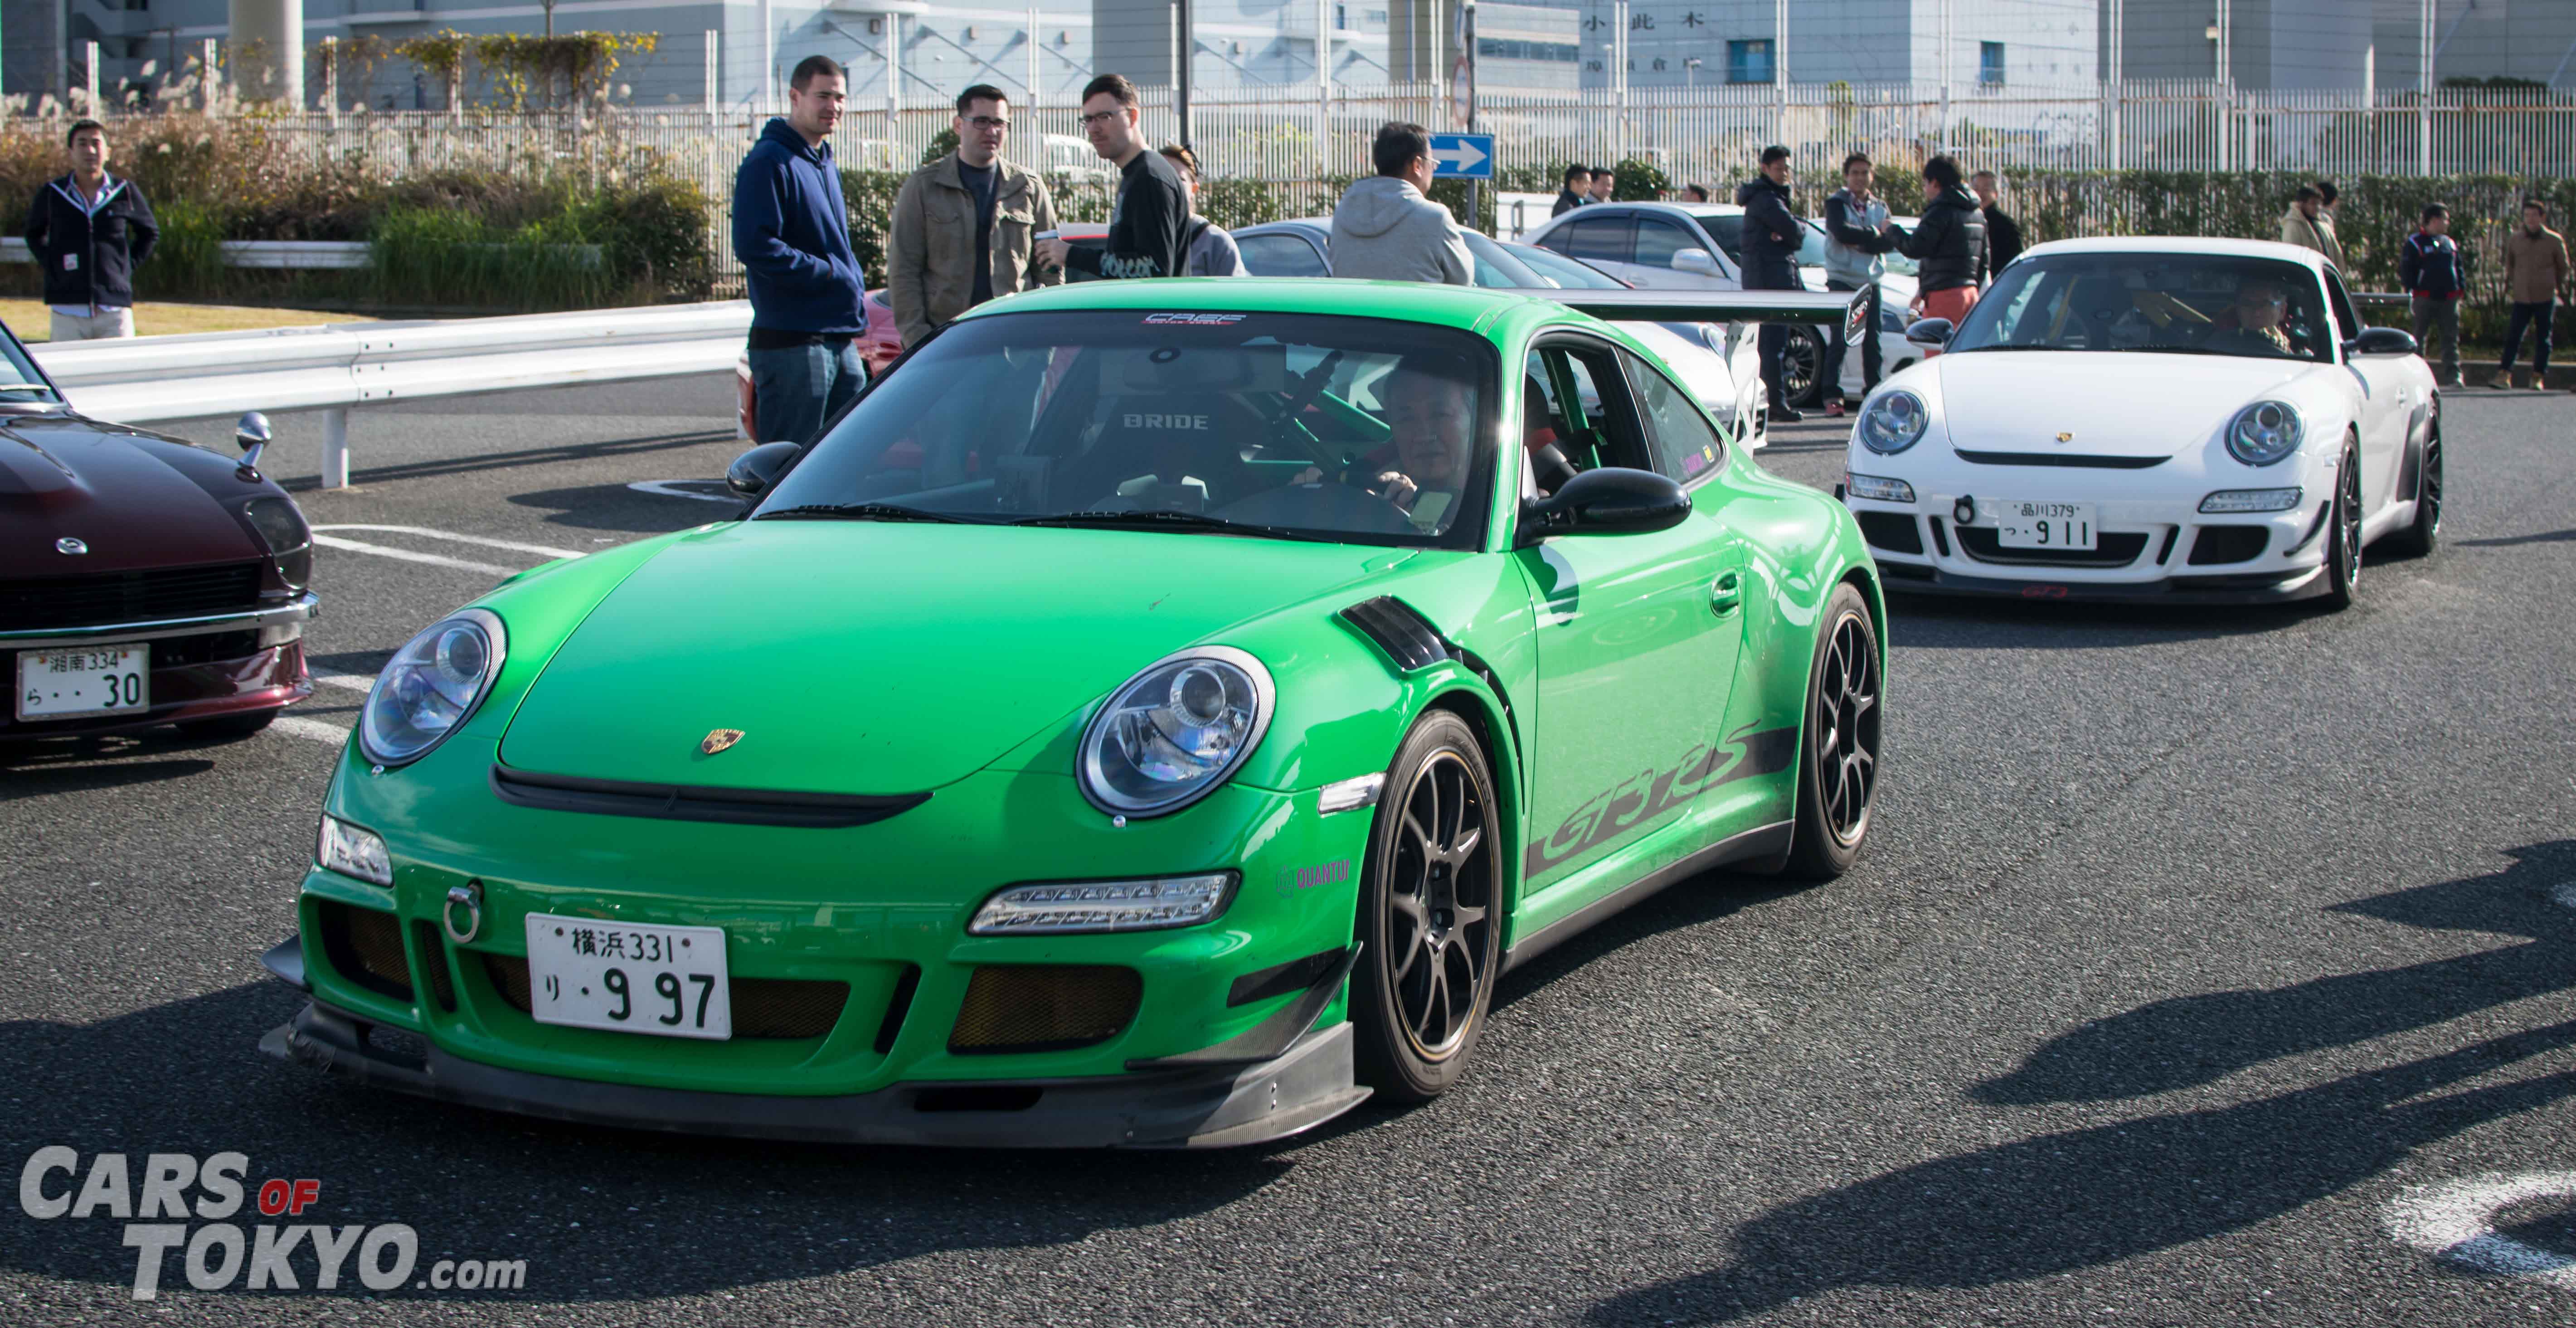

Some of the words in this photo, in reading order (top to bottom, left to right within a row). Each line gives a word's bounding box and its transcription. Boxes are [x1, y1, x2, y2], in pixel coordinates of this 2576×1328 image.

[1123, 414, 1209, 430] BRIDE
[102, 673, 140, 707] 30
[1543, 766, 1659, 860] GT3
[1659, 718, 1761, 808] RS
[572, 927, 673, 964] 横浜331
